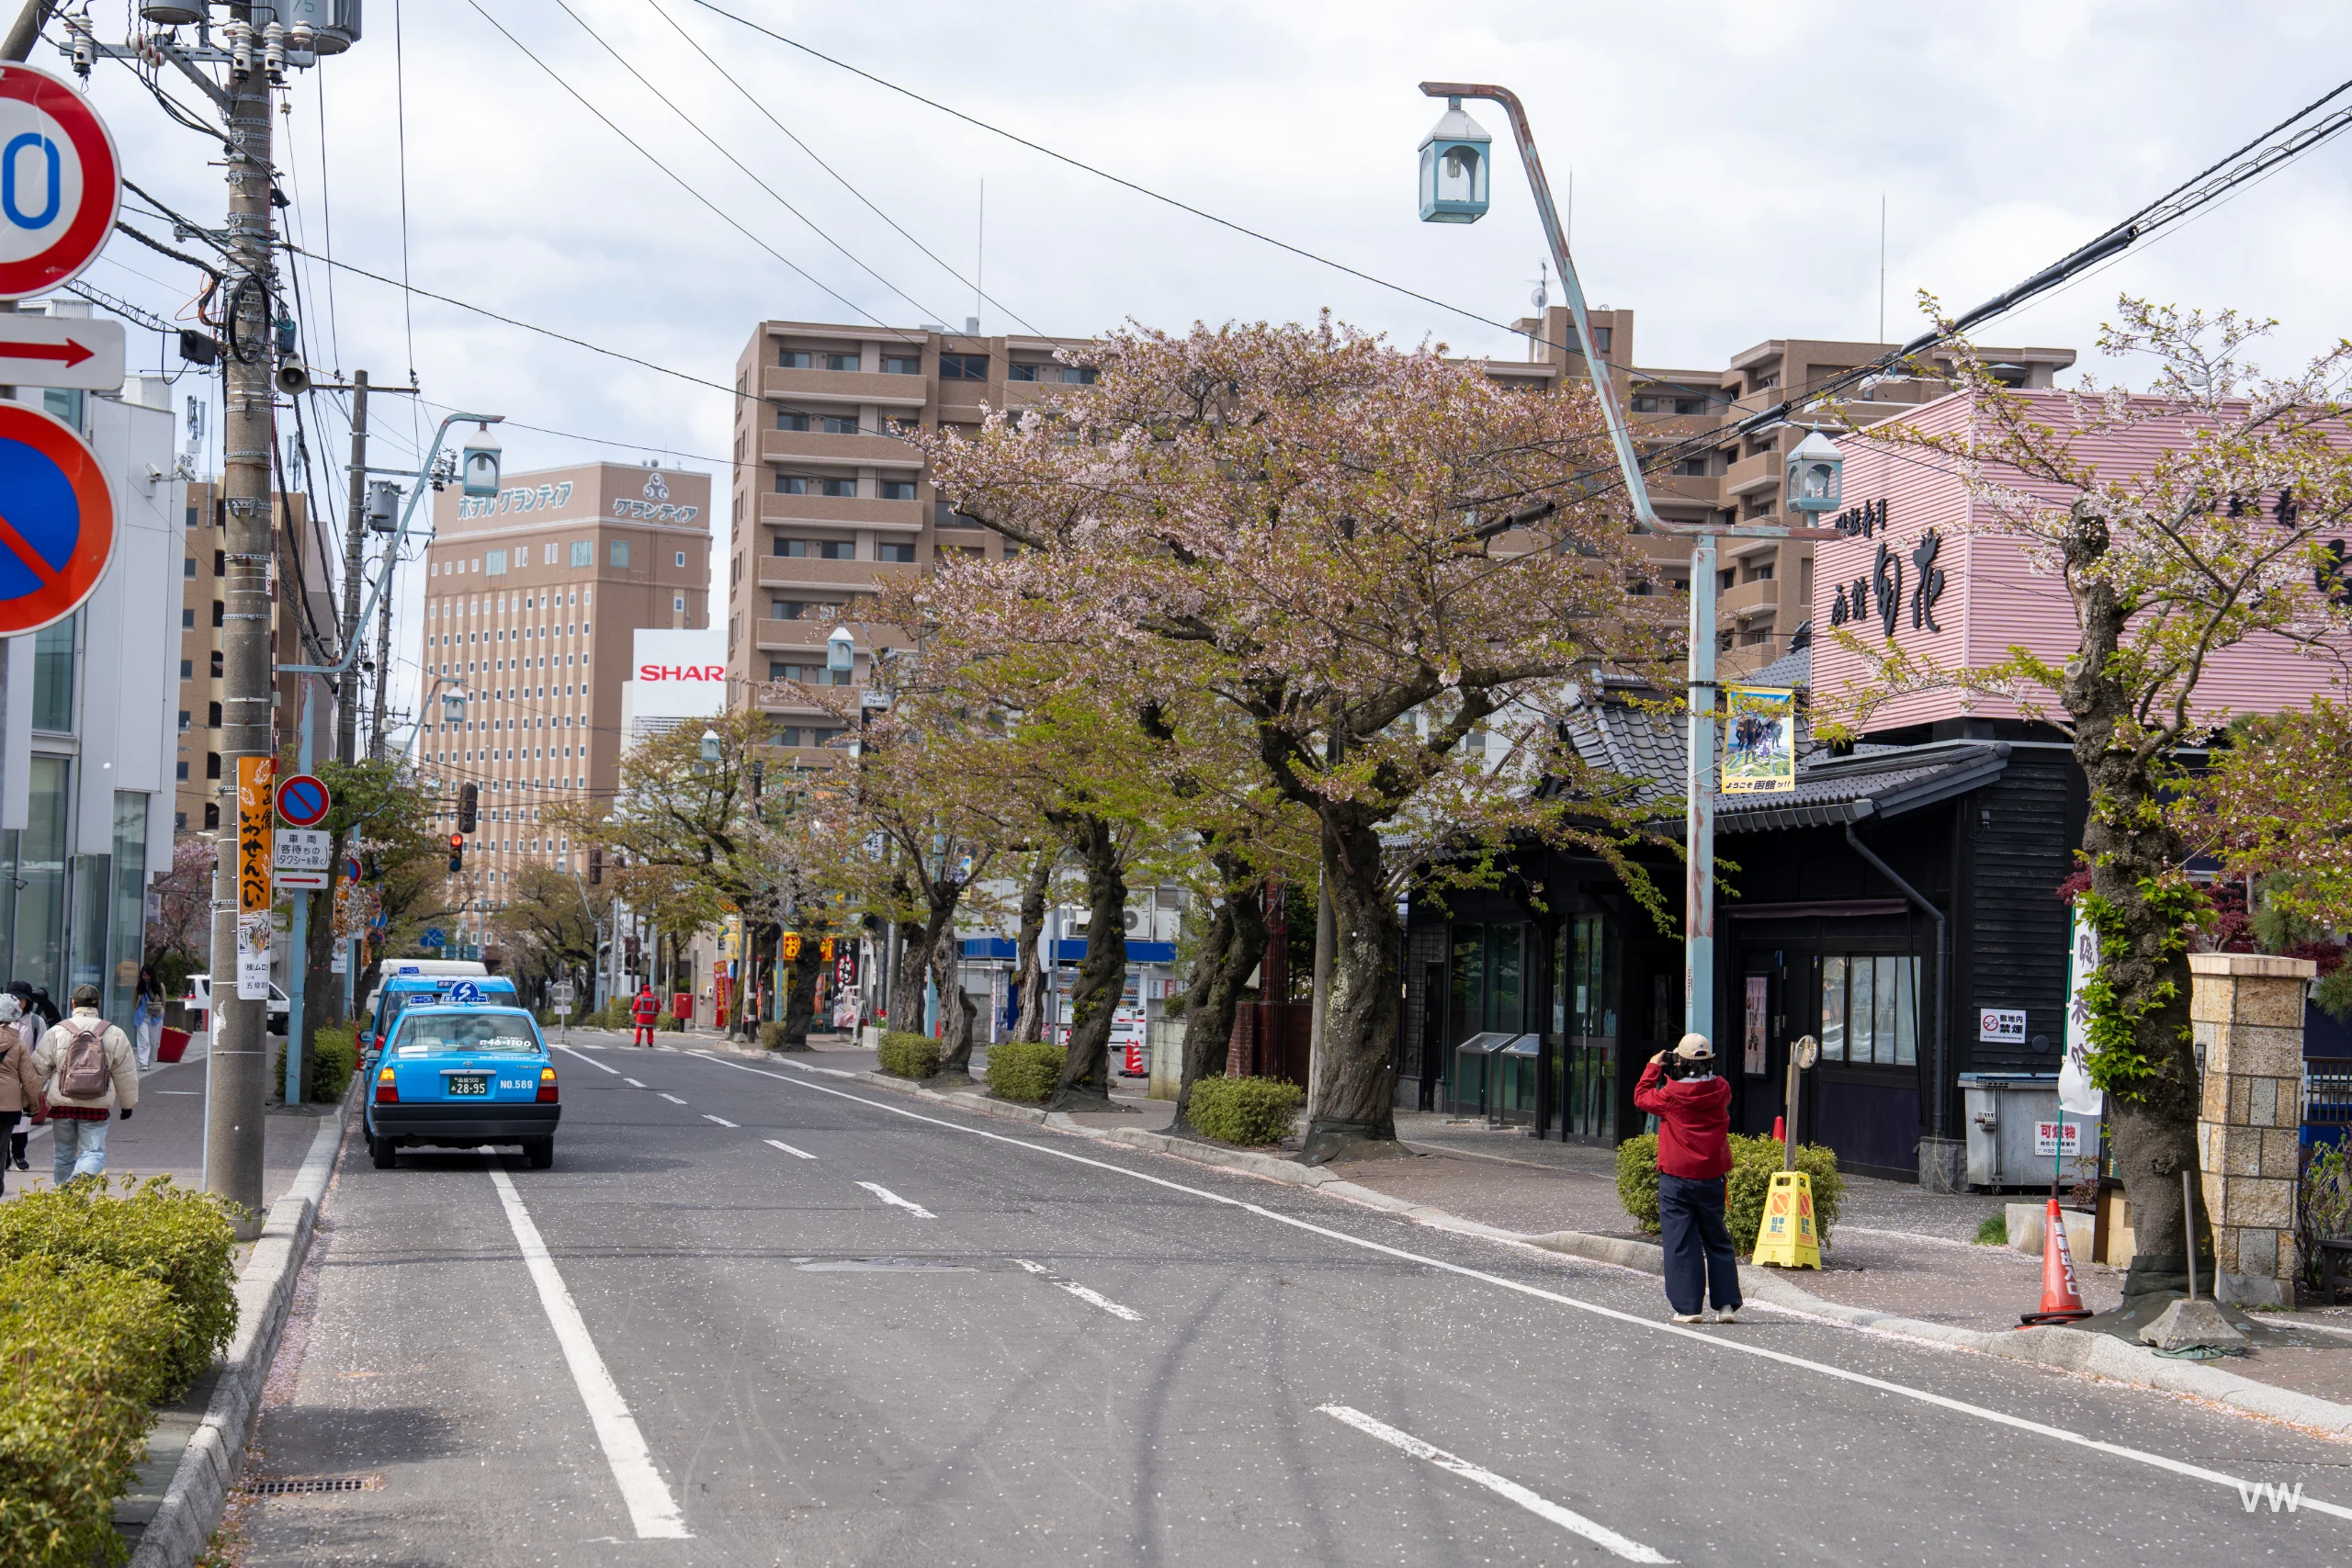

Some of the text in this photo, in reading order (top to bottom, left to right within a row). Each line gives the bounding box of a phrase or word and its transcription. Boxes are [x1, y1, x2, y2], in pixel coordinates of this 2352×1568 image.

[458, 480, 574, 521] ホテル グランティア
[613, 498, 698, 524] グランティア
[640, 664, 728, 682] SHAR
[288, 834, 317, 844] 車両
[1999, 1014, 2023, 1023] 敷地内
[1999, 1023, 2024, 1034] 禁煙
[457, 1083, 486, 1094] 28-95
[500, 1079, 533, 1089] NO.569
[1771, 1216, 1785, 1225] 駐車
[1770, 1224, 1784, 1233] 禁止
